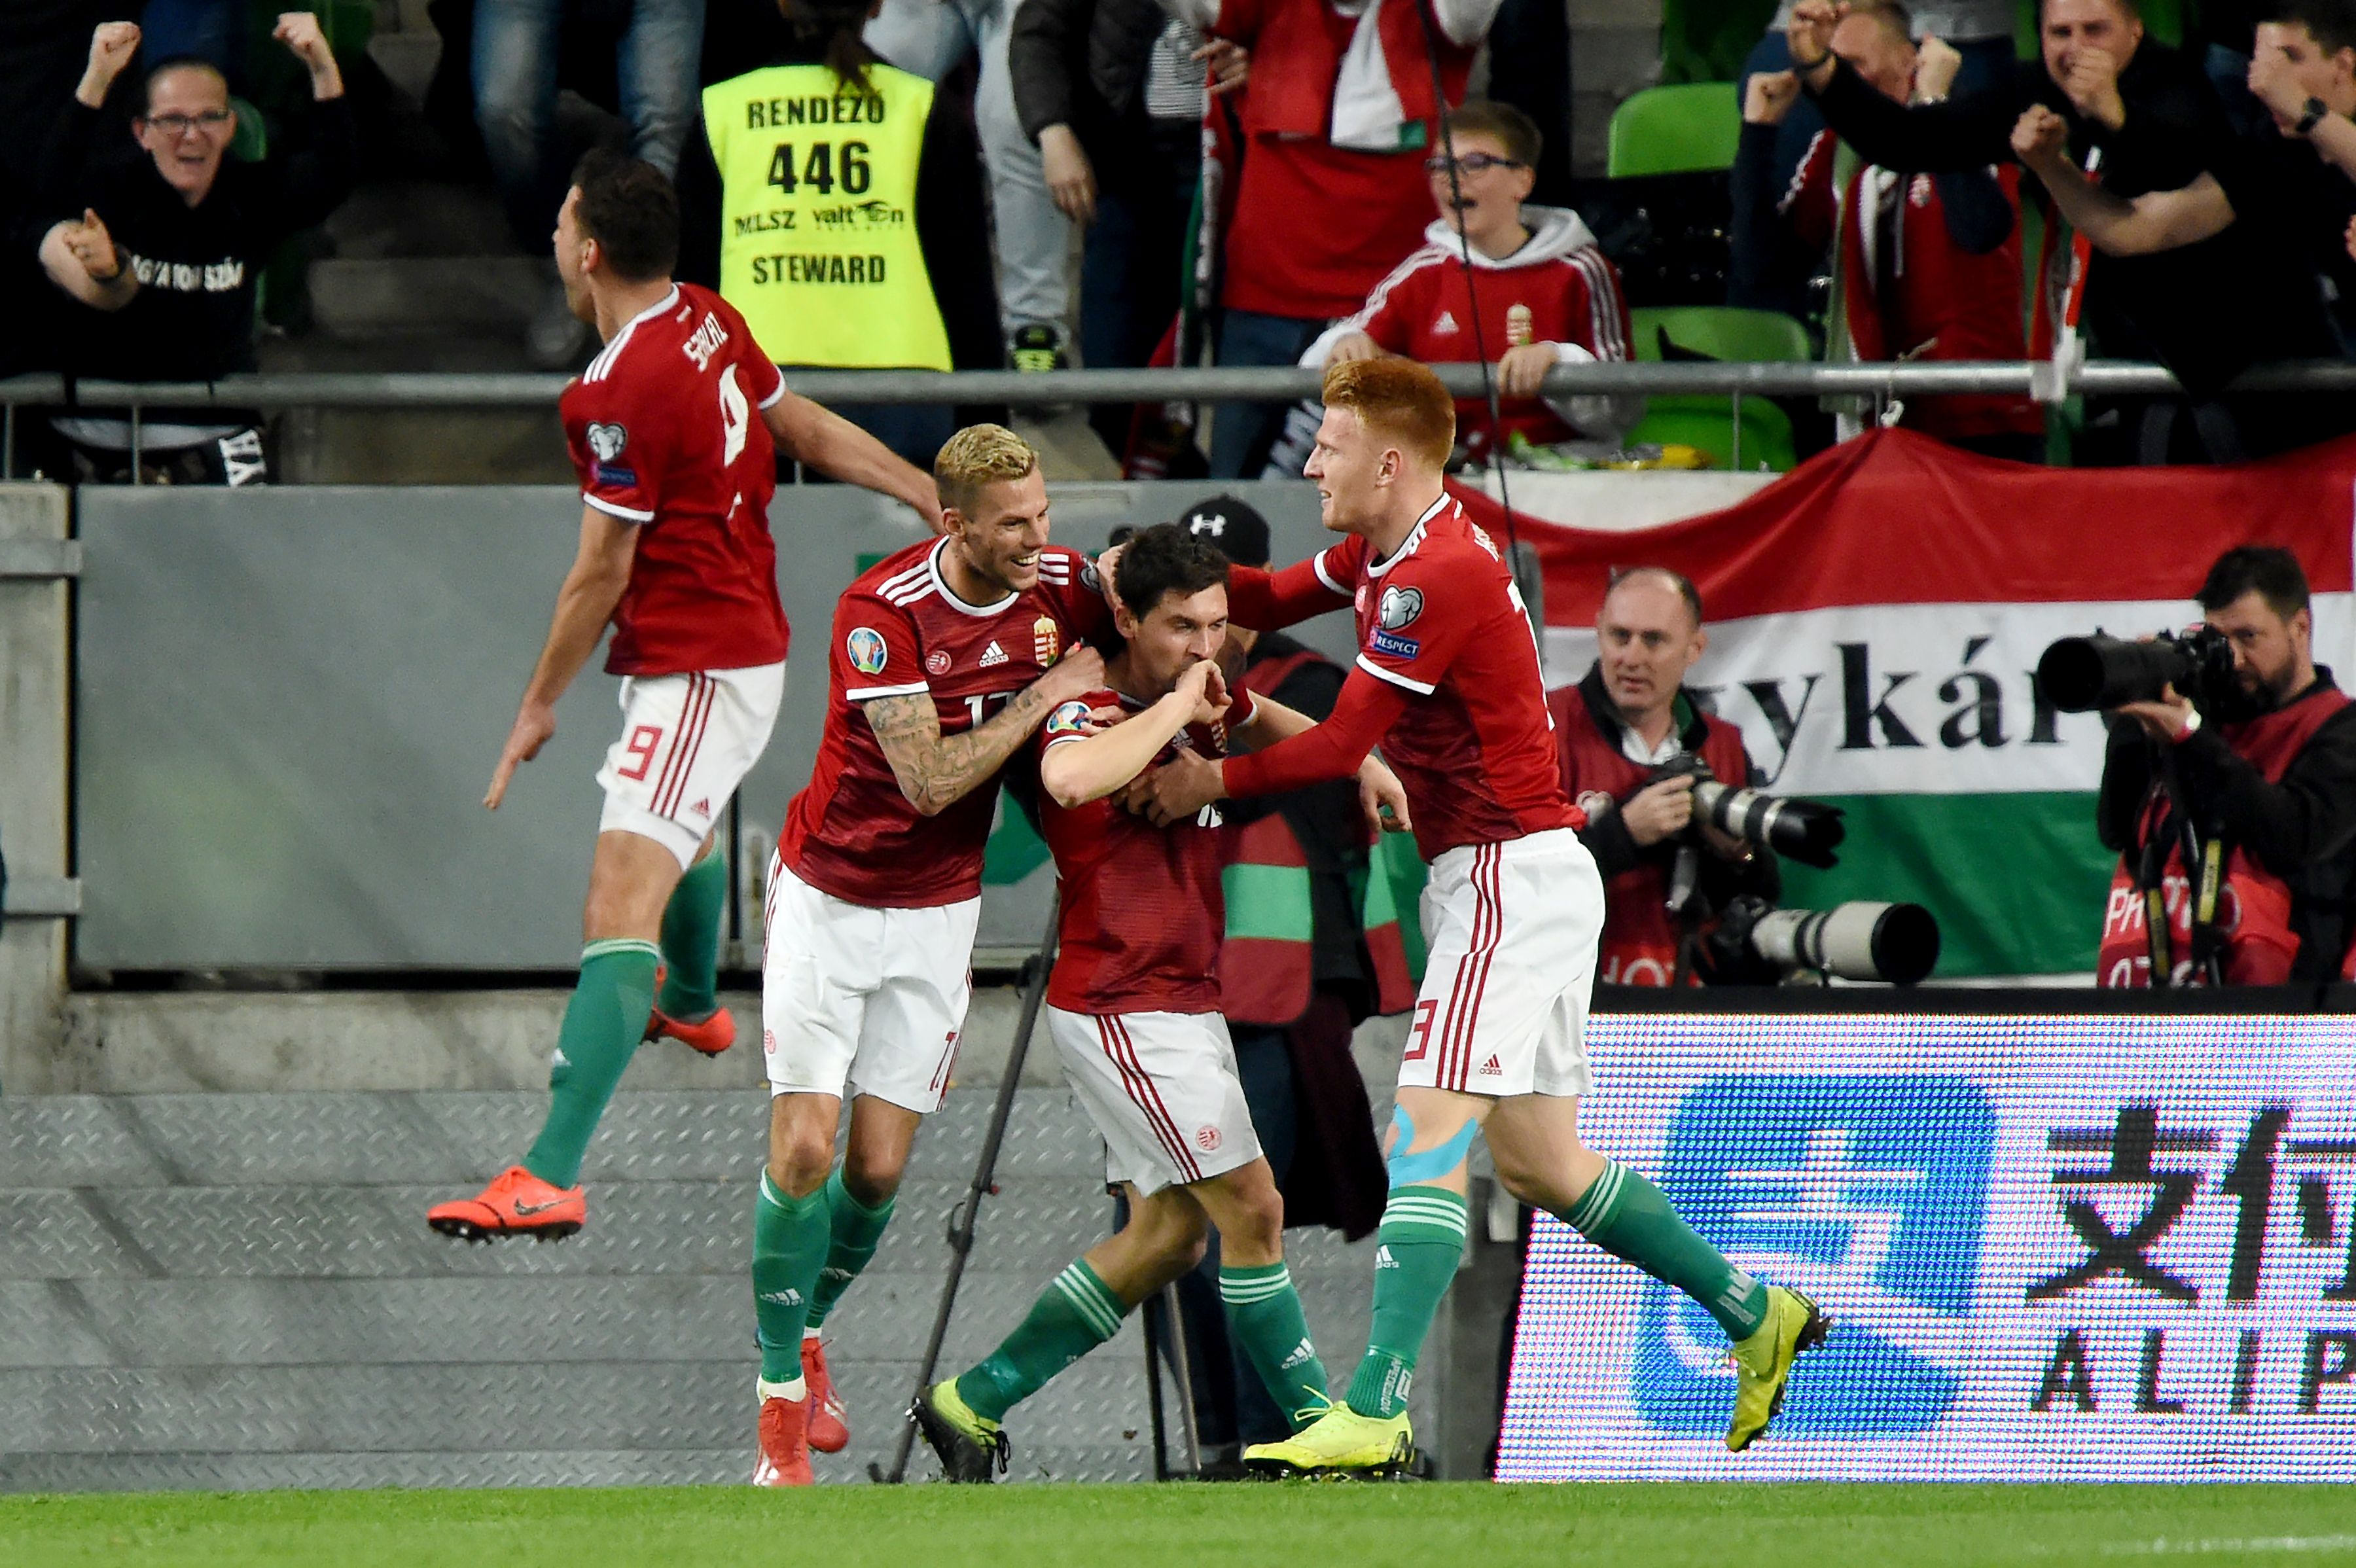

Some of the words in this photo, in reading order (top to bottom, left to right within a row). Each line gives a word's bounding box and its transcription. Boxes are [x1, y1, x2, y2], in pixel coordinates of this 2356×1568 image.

[767, 139, 871, 194] 446
[753, 253, 885, 284] STEWARD
[1376, 635, 1419, 654] RESPECT
[617, 725, 664, 781] 9
[1404, 999, 1439, 1061] 3
[2030, 1327, 2356, 1414] ALIP
